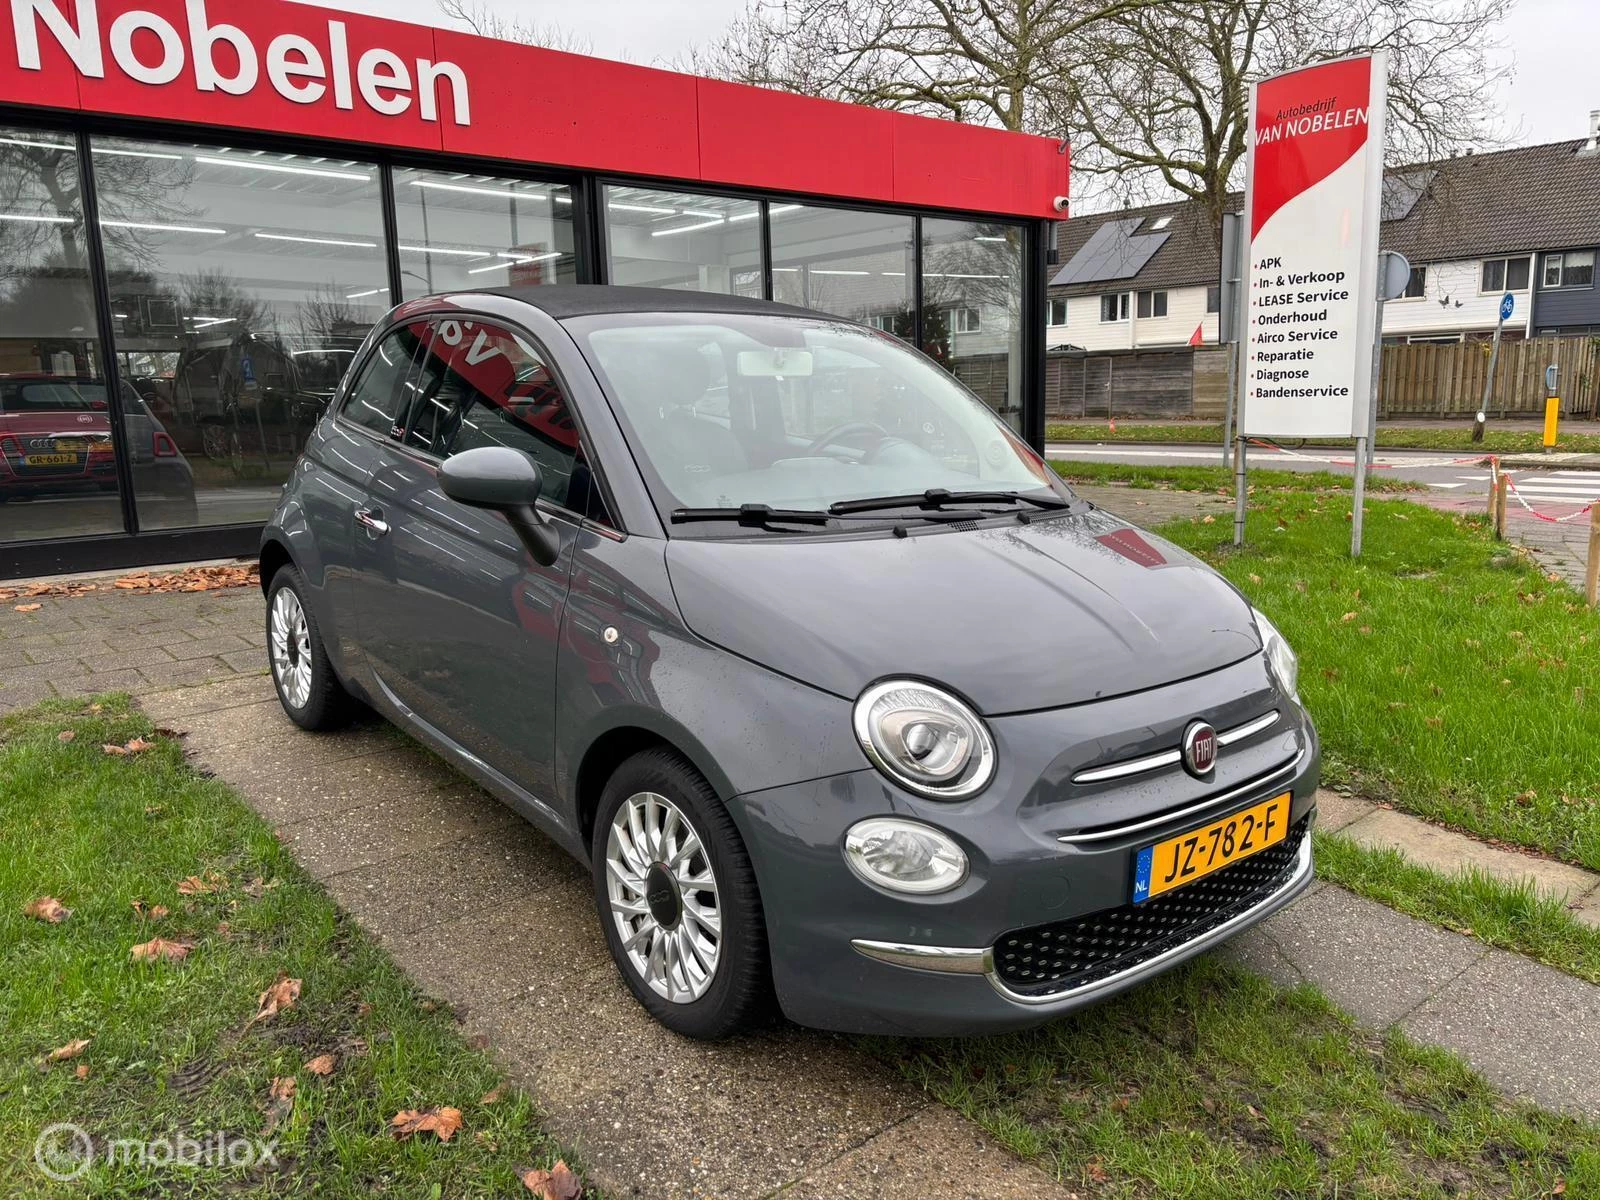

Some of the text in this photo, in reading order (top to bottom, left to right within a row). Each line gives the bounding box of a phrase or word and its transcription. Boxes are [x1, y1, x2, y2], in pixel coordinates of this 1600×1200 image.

[12, 0, 471, 126] Nobelen
[1275, 97, 1337, 120] Autobedrijf
[1255, 106, 1370, 147] VAN NOBELEN
[1259, 257, 1282, 270] APK
[1259, 271, 1345, 288] In- & Verkoop
[1258, 288, 1349, 307] LEASE Service
[1258, 308, 1328, 326] Onderhoud
[1257, 328, 1338, 344] Airco Service
[1257, 348, 1315, 364] Reparatie
[1256, 368, 1310, 383] Diagnose
[1256, 384, 1349, 398] Bandenservice
[28, 454, 74, 465] GR-661-Z
[1195, 737, 1213, 763] FIAT
[1164, 803, 1279, 884] JZ-782-F
[1135, 881, 1148, 894] NL
